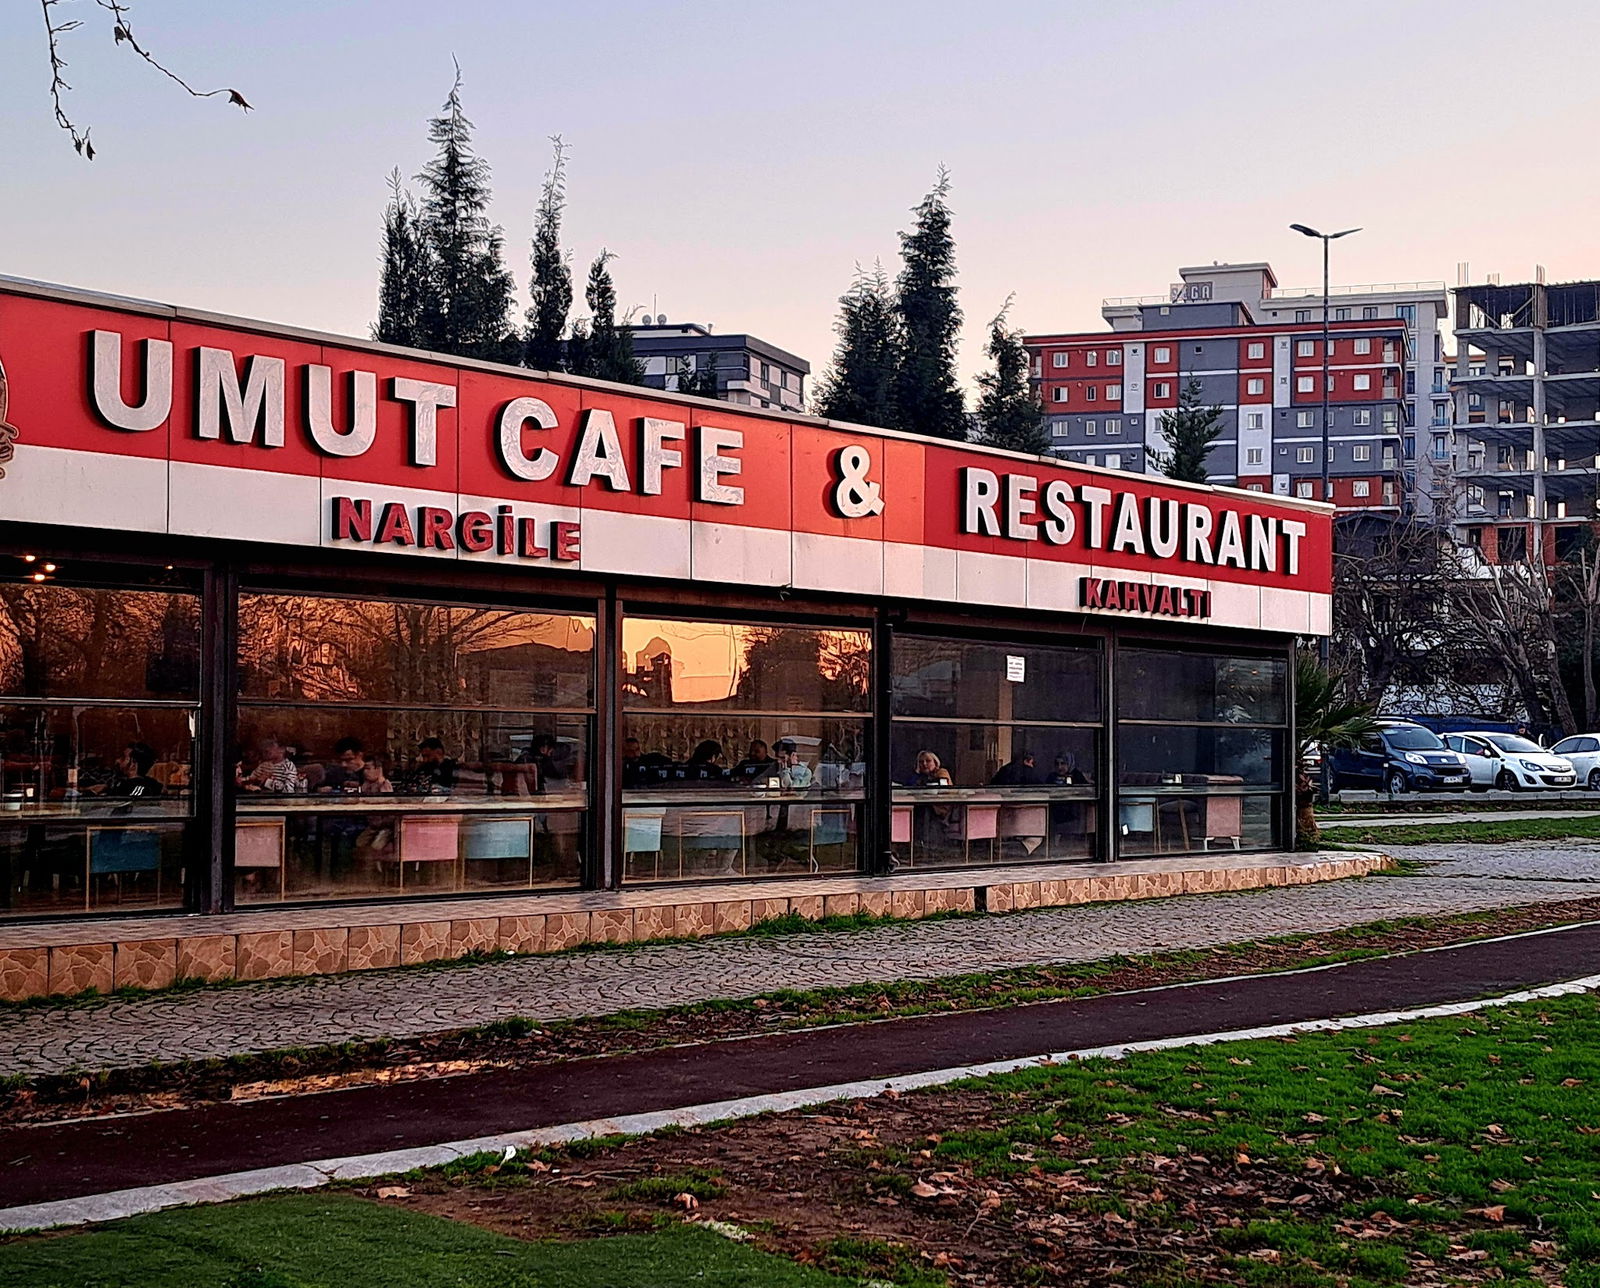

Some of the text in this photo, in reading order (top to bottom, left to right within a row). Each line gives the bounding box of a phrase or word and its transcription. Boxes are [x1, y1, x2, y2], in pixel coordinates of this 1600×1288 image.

[92, 328, 1306, 576] UMUT CAFE & RESTAURANT
[334, 495, 581, 562] NARGİLE
[1082, 577, 1212, 618] KAHVALTI
